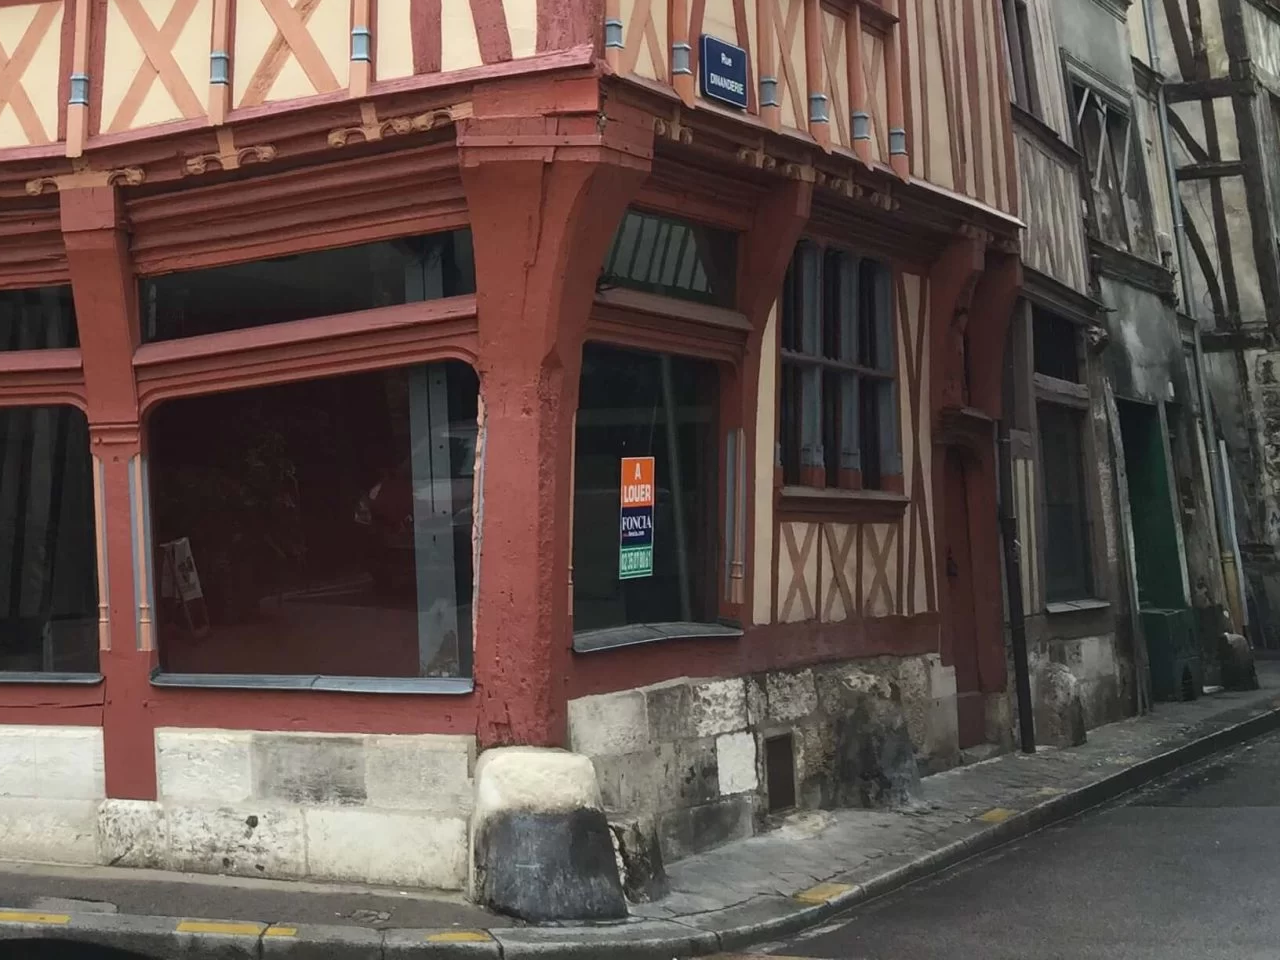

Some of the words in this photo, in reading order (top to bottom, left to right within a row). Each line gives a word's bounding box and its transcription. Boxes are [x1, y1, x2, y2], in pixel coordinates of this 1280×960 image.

[721, 52, 732, 67] Rue
[710, 72, 744, 95] DINANDERIE
[634, 462, 642, 480] A
[623, 484, 651, 503] LOUER
[622, 515, 652, 530] FONCIA
